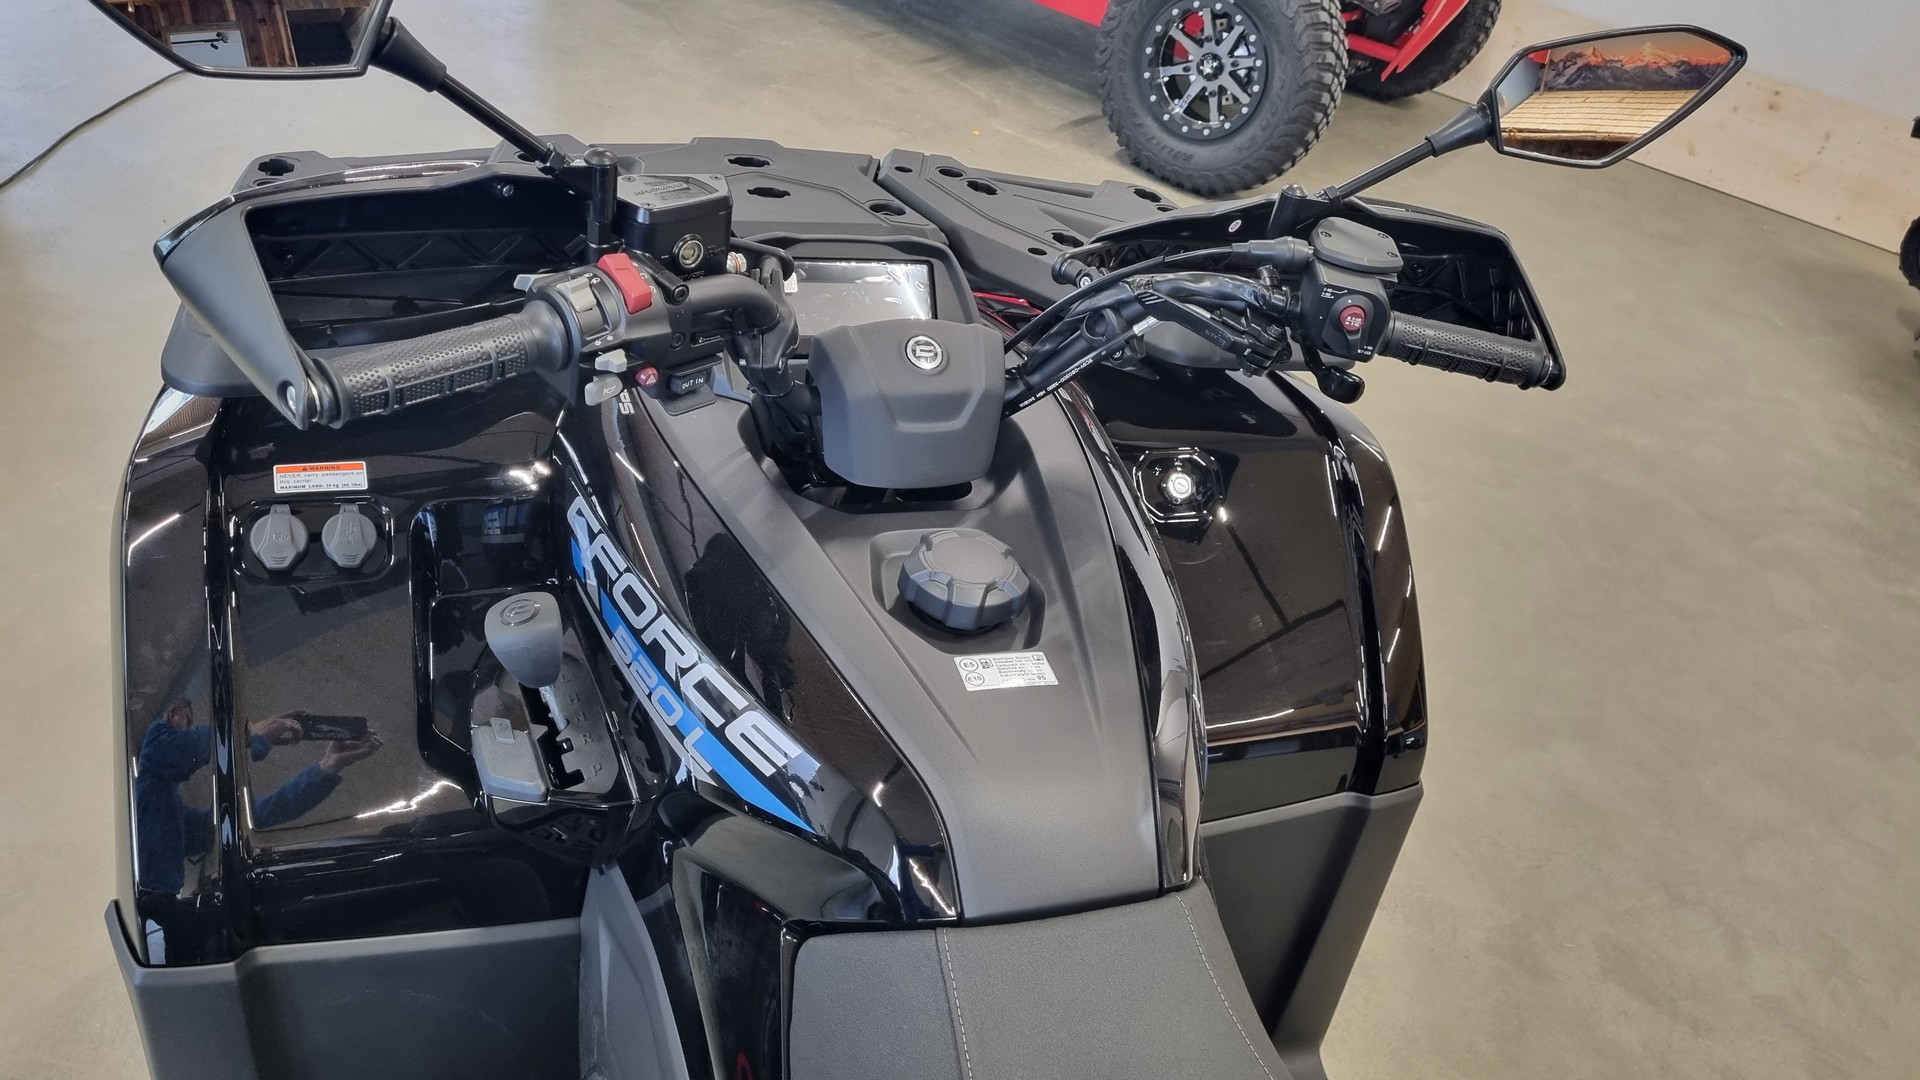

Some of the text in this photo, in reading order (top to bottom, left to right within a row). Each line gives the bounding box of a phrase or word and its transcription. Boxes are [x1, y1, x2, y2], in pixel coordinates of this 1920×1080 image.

[681, 376, 704, 390] OUT IN
[619, 387, 635, 415] PS
[566, 495, 804, 777] CFORCE
[562, 673, 571, 684] L
[568, 692, 579, 705] H
[611, 625, 714, 773] 520 L
[574, 711, 588, 725] N
[580, 732, 594, 745] R
[590, 762, 603, 777] P
